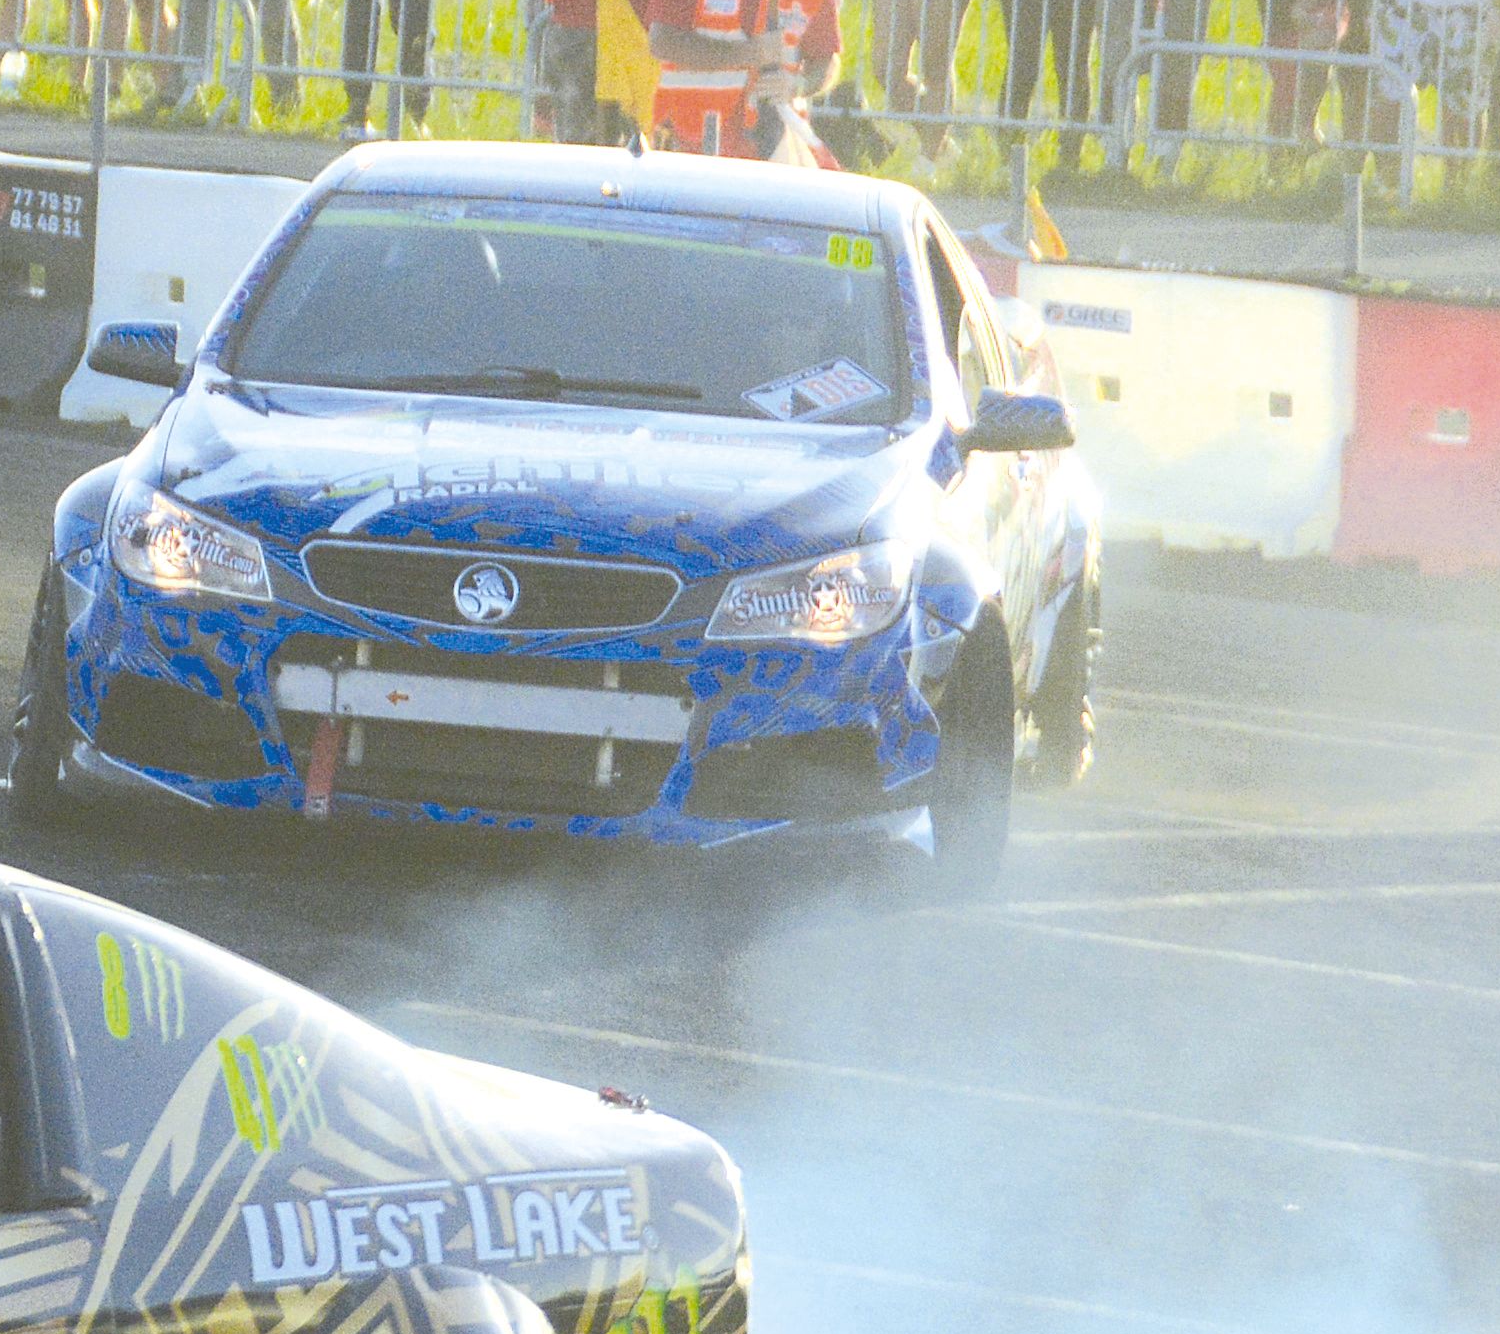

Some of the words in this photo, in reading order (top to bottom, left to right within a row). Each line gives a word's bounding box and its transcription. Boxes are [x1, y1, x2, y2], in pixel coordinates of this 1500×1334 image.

[11, 186, 34, 207] 77
[37, 190, 60, 212] 79
[62, 194, 83, 215] 57
[9, 208, 34, 230] 81
[62, 216, 83, 239] 31
[1067, 304, 1127, 325] GREE
[392, 479, 540, 504] RADIAL
[96, 932, 131, 1040] 8
[217, 1034, 281, 1153] 47
[242, 1197, 446, 1284] WEST
[464, 1185, 641, 1262] LAKE
